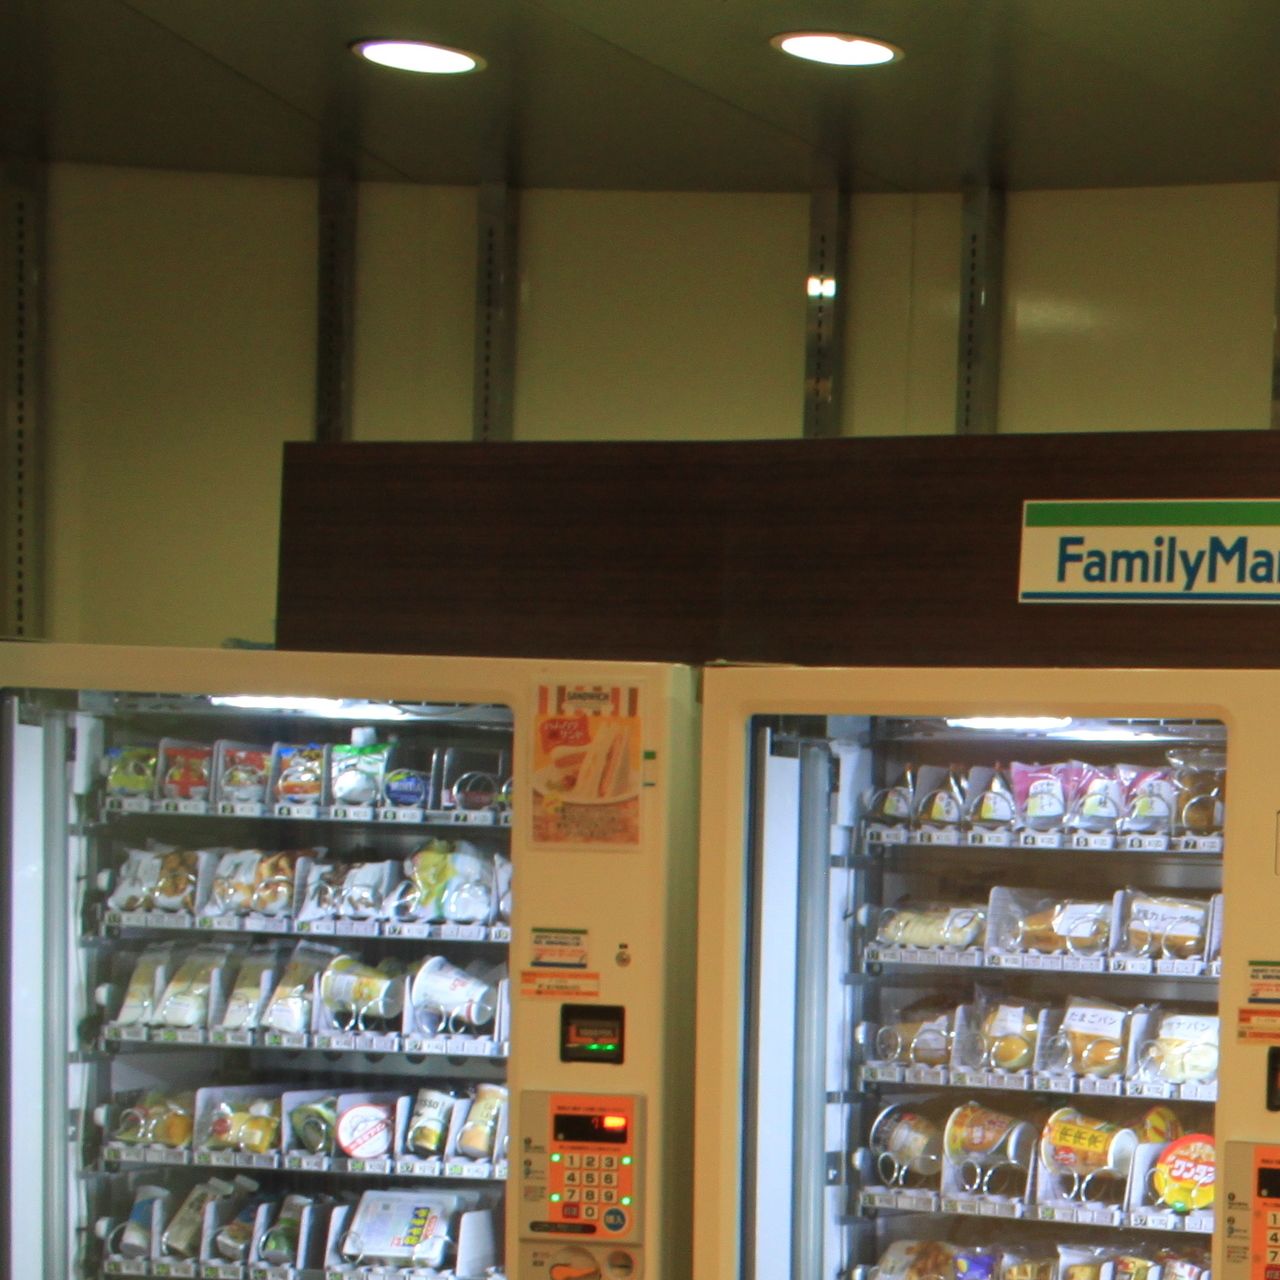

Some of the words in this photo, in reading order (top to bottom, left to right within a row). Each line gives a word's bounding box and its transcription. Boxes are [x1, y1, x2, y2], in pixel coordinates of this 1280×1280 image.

[568, 1156, 575, 1166] 1
[585, 1156, 596, 1167] 2
[604, 1157, 615, 1168] 3
[566, 1173, 576, 1183] 4
[585, 1173, 595, 1184] 5
[604, 1174, 614, 1185] 6
[566, 1191, 576, 1200] 7
[585, 1191, 595, 1201] 8
[604, 1191, 614, 1202] 9
[585, 1207, 595, 1218] 0
[1272, 1213, 1278, 1224] 1
[1269, 1233, 1279, 1244] 4
[1270, 1251, 1279, 1262] 7
